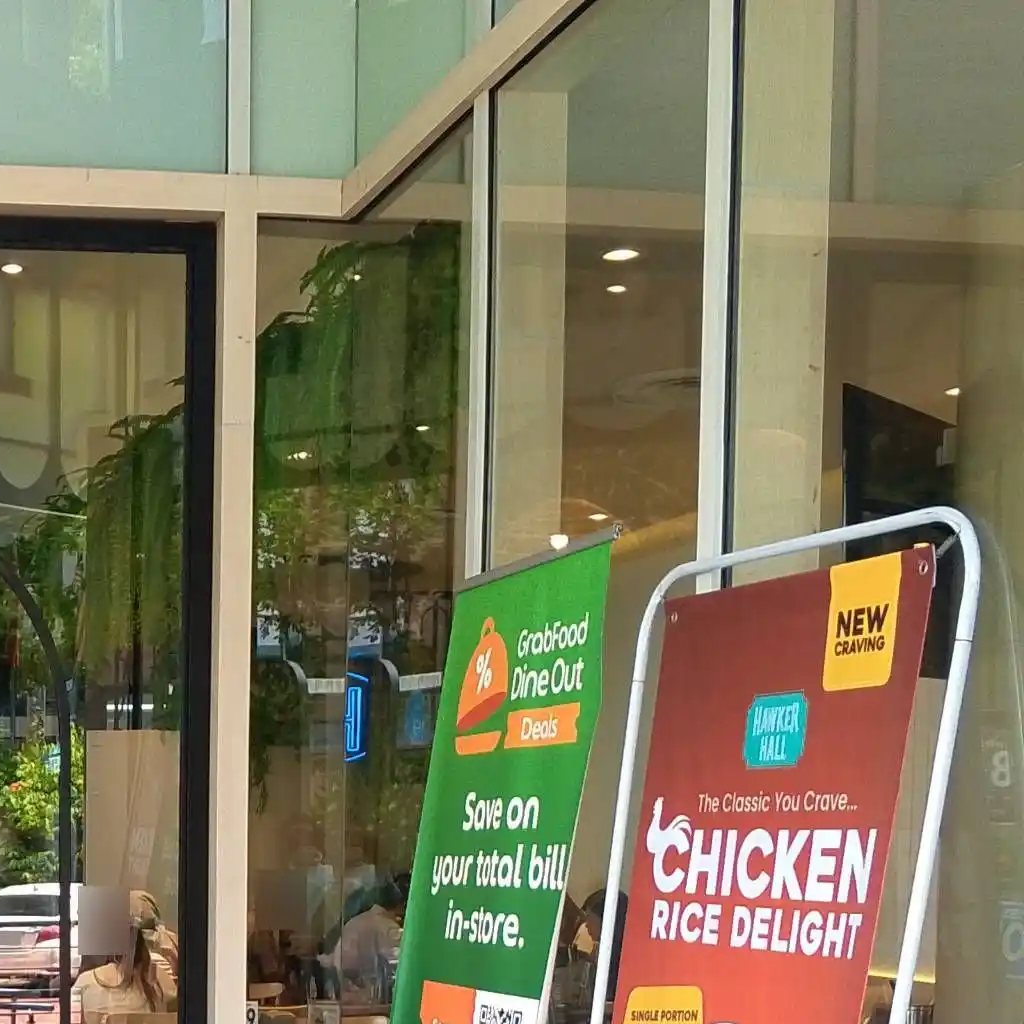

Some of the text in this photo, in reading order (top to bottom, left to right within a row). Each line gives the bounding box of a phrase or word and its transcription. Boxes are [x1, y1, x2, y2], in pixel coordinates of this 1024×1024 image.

[517, 612, 589, 656] GrabFood
[836, 603, 890, 638] NEW
[834, 635, 885, 657] CRAVING
[510, 657, 584, 701] Dine Out
[520, 715, 558, 740] Deals
[752, 702, 800, 736] HAWKER
[759, 735, 787, 761] HALL
[462, 791, 540, 831] Save on
[698, 790, 858, 812] The Classic You Crave...
[431, 844, 567, 895] your total bill
[647, 820, 877, 904] CHICKEN
[444, 899, 525, 949] in-store.
[651, 900, 863, 960] RICE DELIGHT
[631, 1009, 698, 1022] SINGLE PORTION
